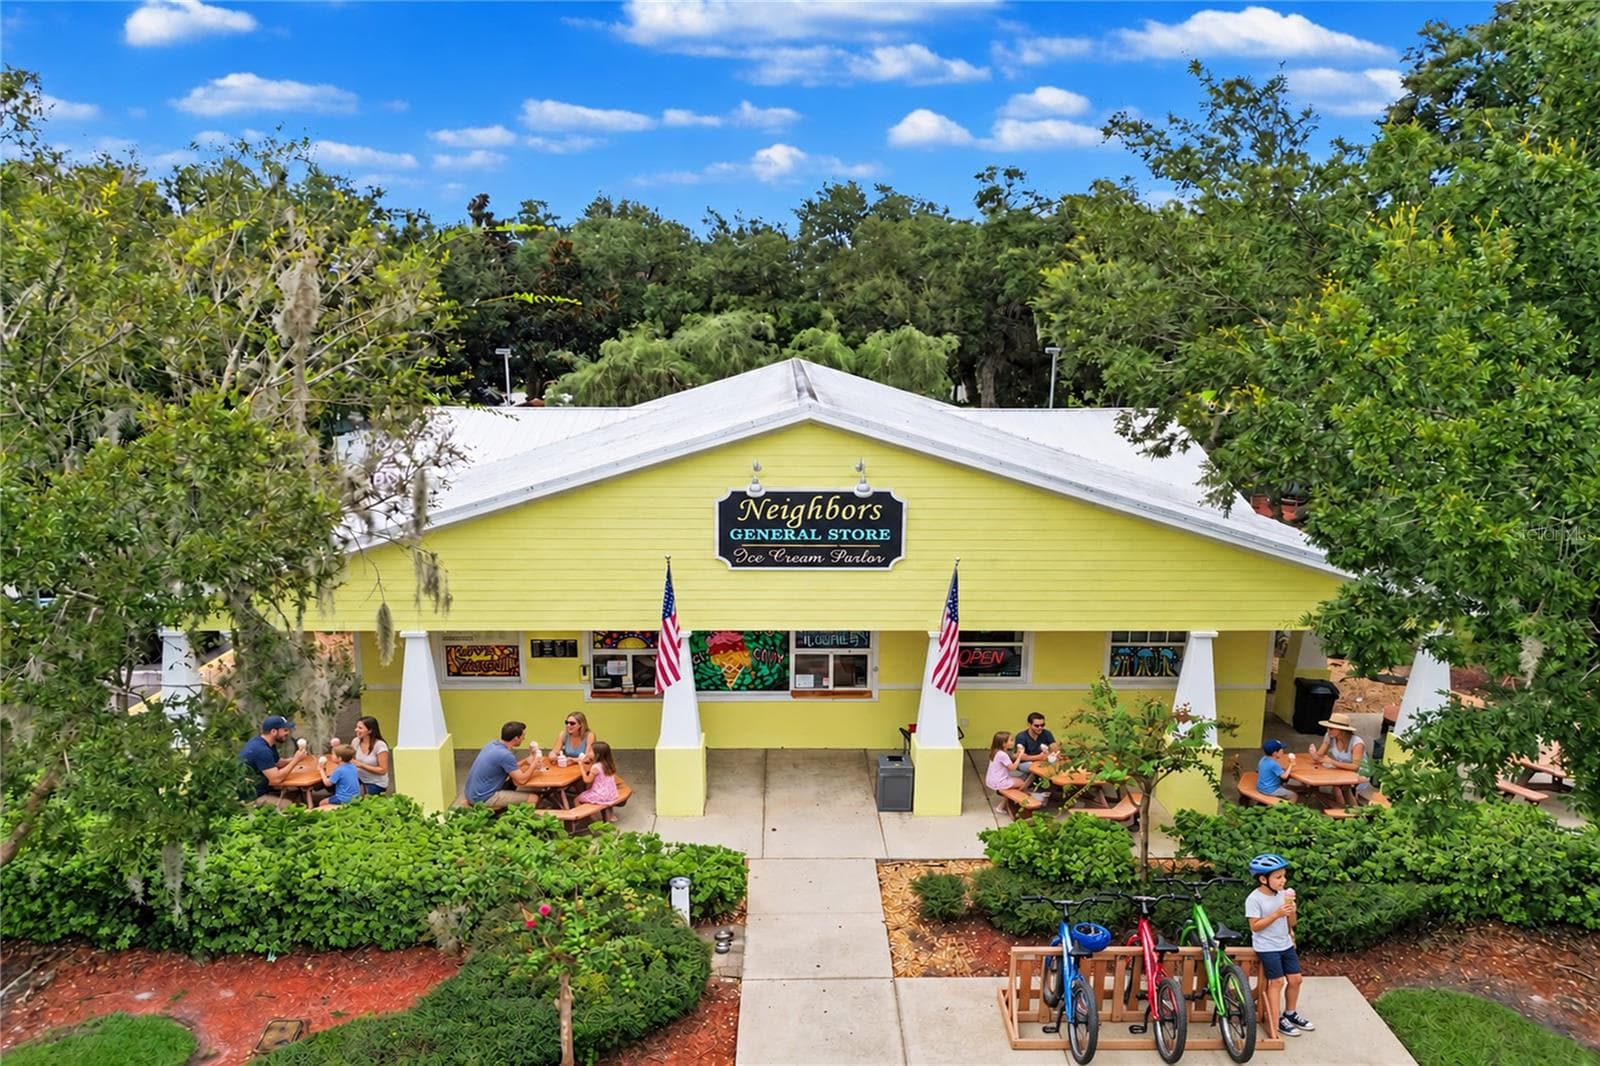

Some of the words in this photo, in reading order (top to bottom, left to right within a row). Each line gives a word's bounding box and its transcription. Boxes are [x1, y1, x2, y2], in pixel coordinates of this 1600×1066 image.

[738, 496, 882, 528] Neighbors
[729, 529, 822, 541] GENERAL
[828, 529, 891, 541] STORE
[733, 548, 765, 564] Ice
[770, 548, 825, 564] Cream
[831, 548, 886, 564] Parlor
[959, 649, 1005, 665] OPEN
